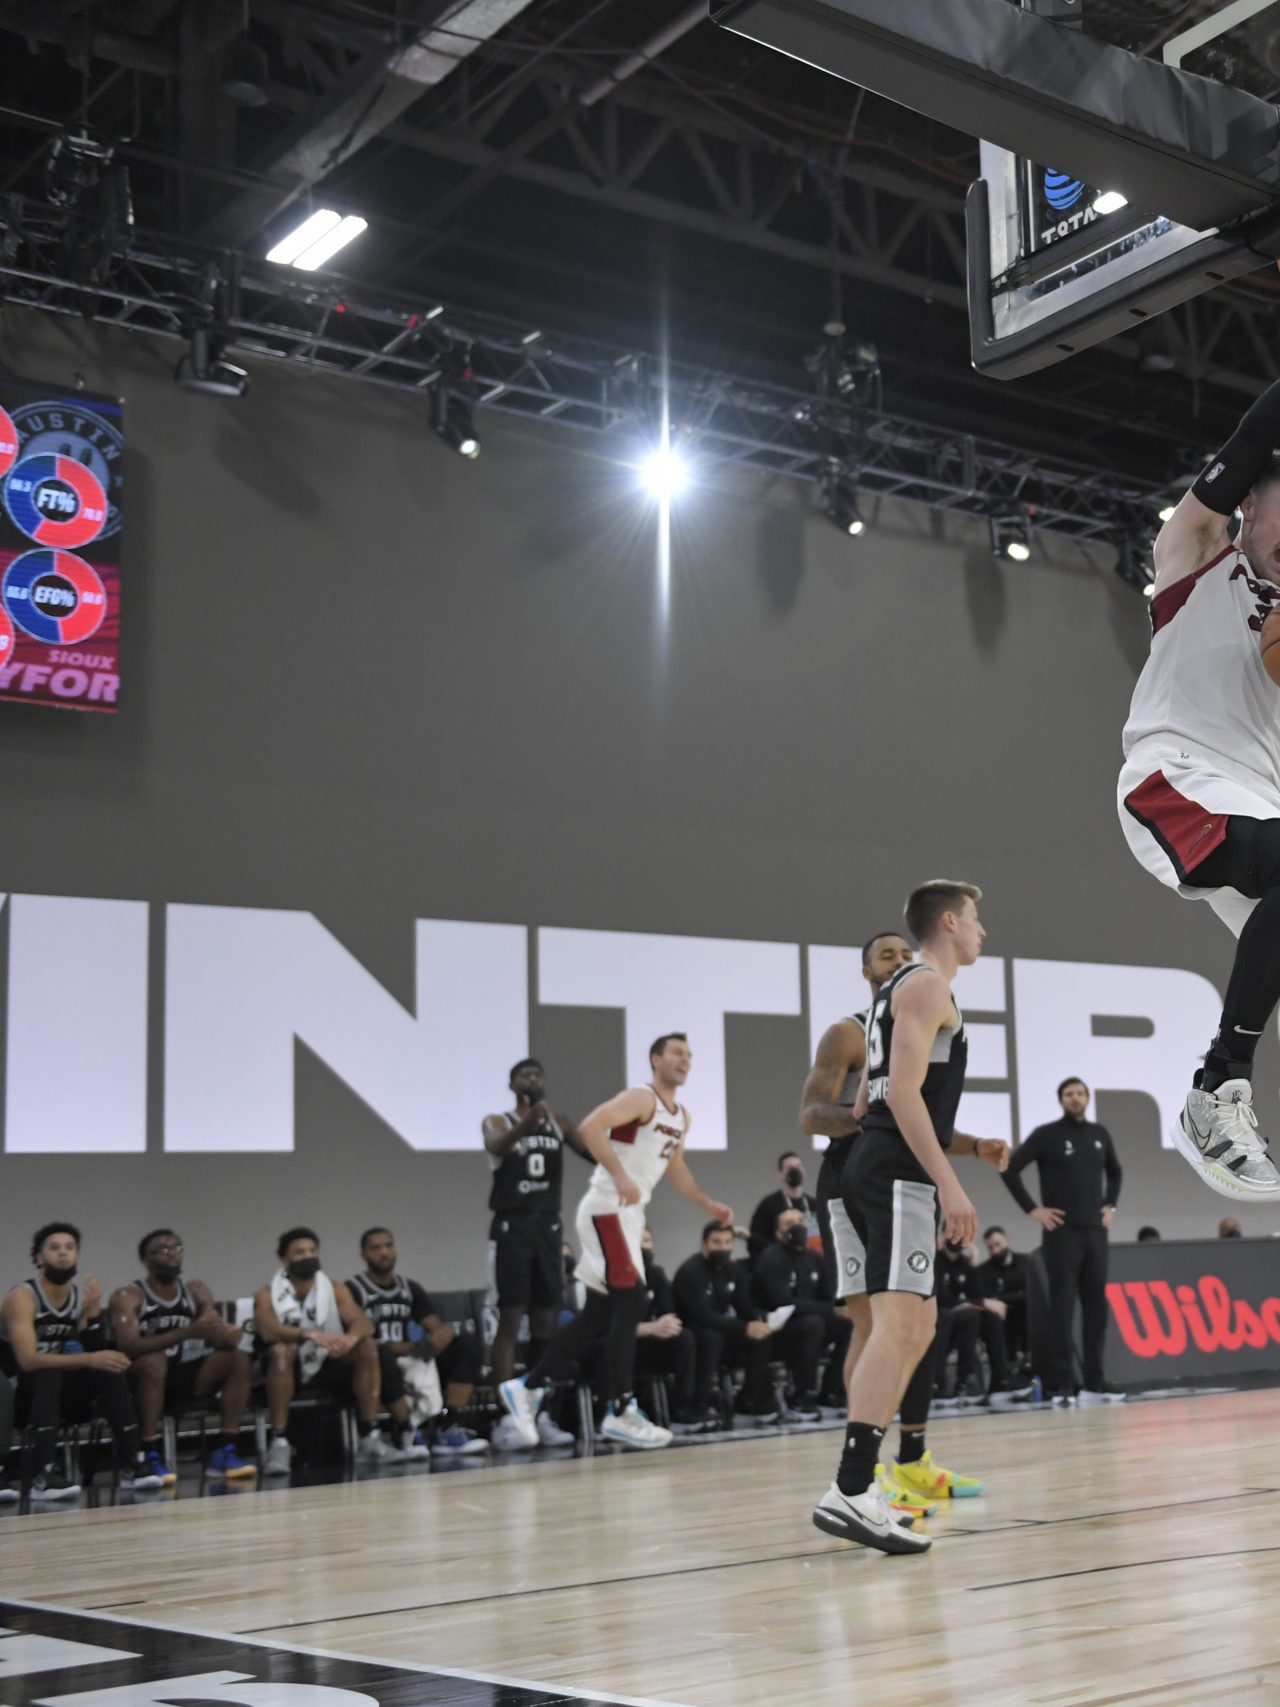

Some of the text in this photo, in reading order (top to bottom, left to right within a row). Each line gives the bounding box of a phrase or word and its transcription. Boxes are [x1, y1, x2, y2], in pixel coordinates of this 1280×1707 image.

[37, 488, 77, 513] FT%
[49, 650, 115, 669] SIOUX
[0, 893, 1226, 1153] INTR
[528, 1153, 545, 1177] 0
